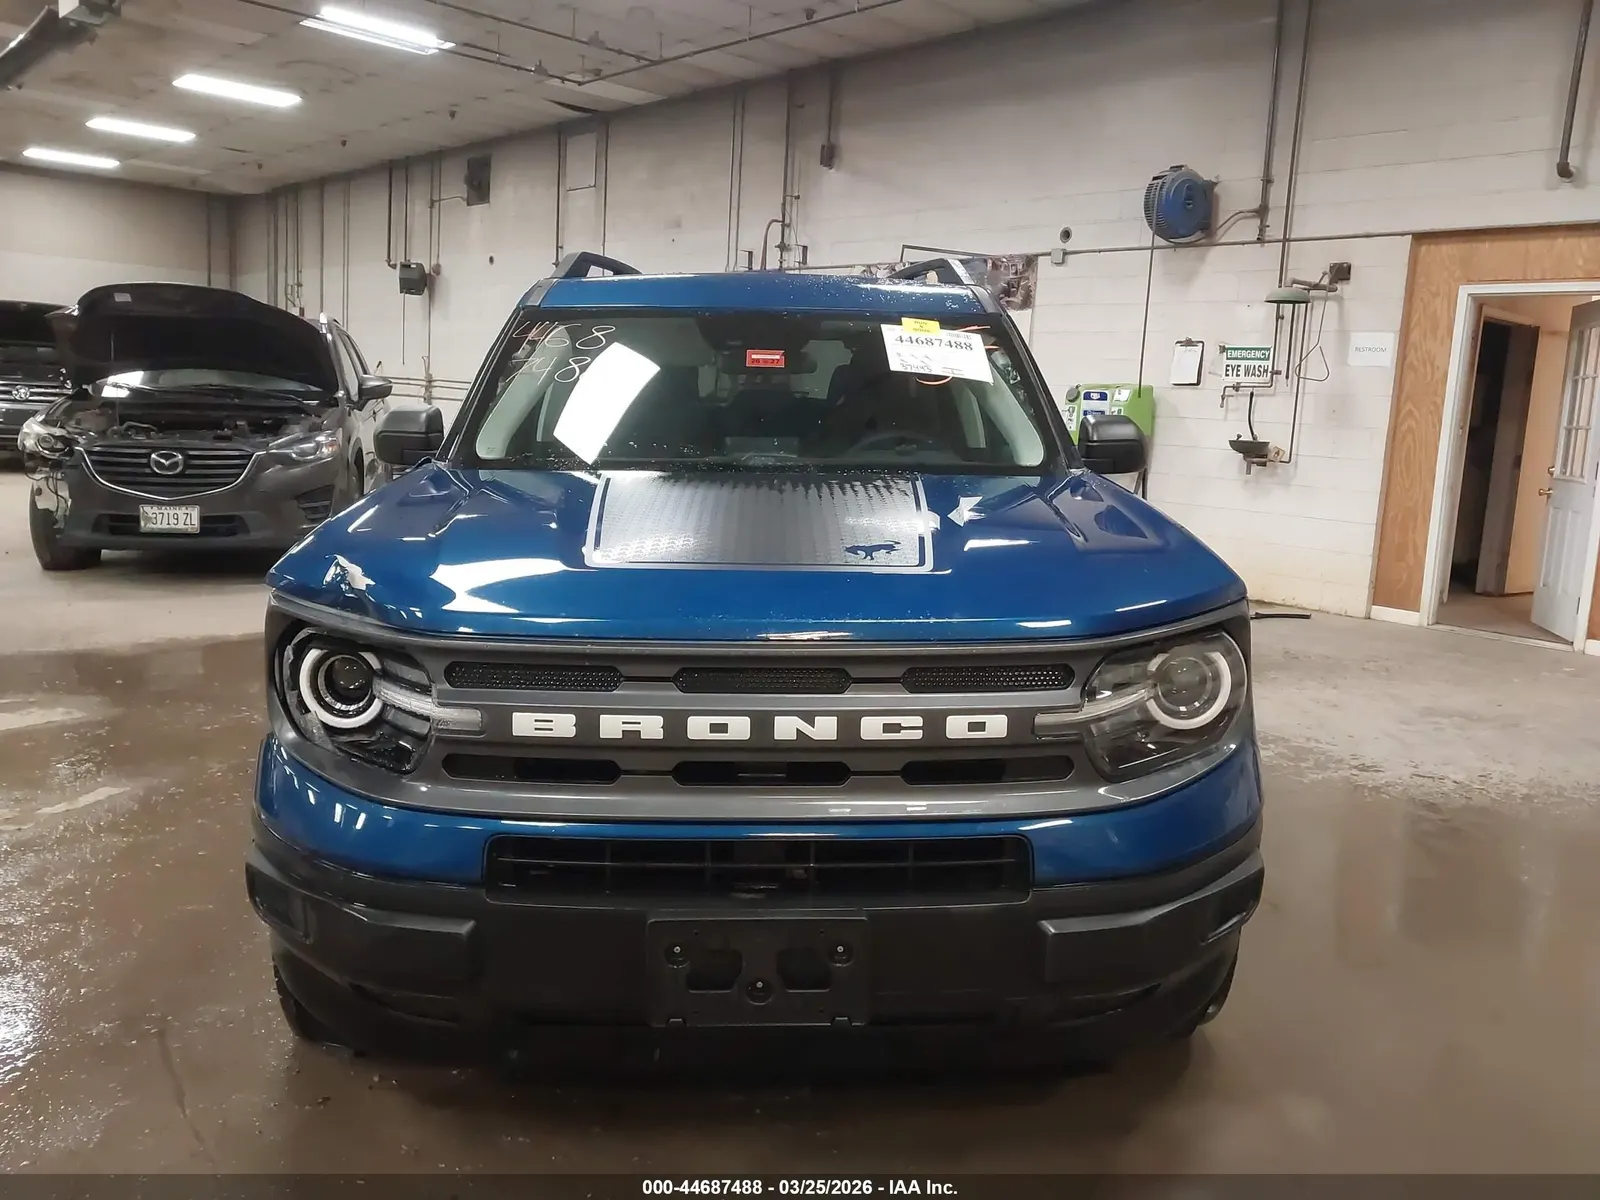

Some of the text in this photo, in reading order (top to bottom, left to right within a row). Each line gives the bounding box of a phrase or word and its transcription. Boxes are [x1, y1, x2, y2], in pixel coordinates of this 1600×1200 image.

[512, 321, 616, 354] 4468
[895, 335, 974, 352] 44687488
[1227, 349, 1270, 359] EMERGENCY
[505, 356, 592, 386] 748
[1225, 364, 1269, 379] EYE WASH
[151, 512, 196, 526] 3719 ZL
[511, 711, 1009, 741] BRONCO
